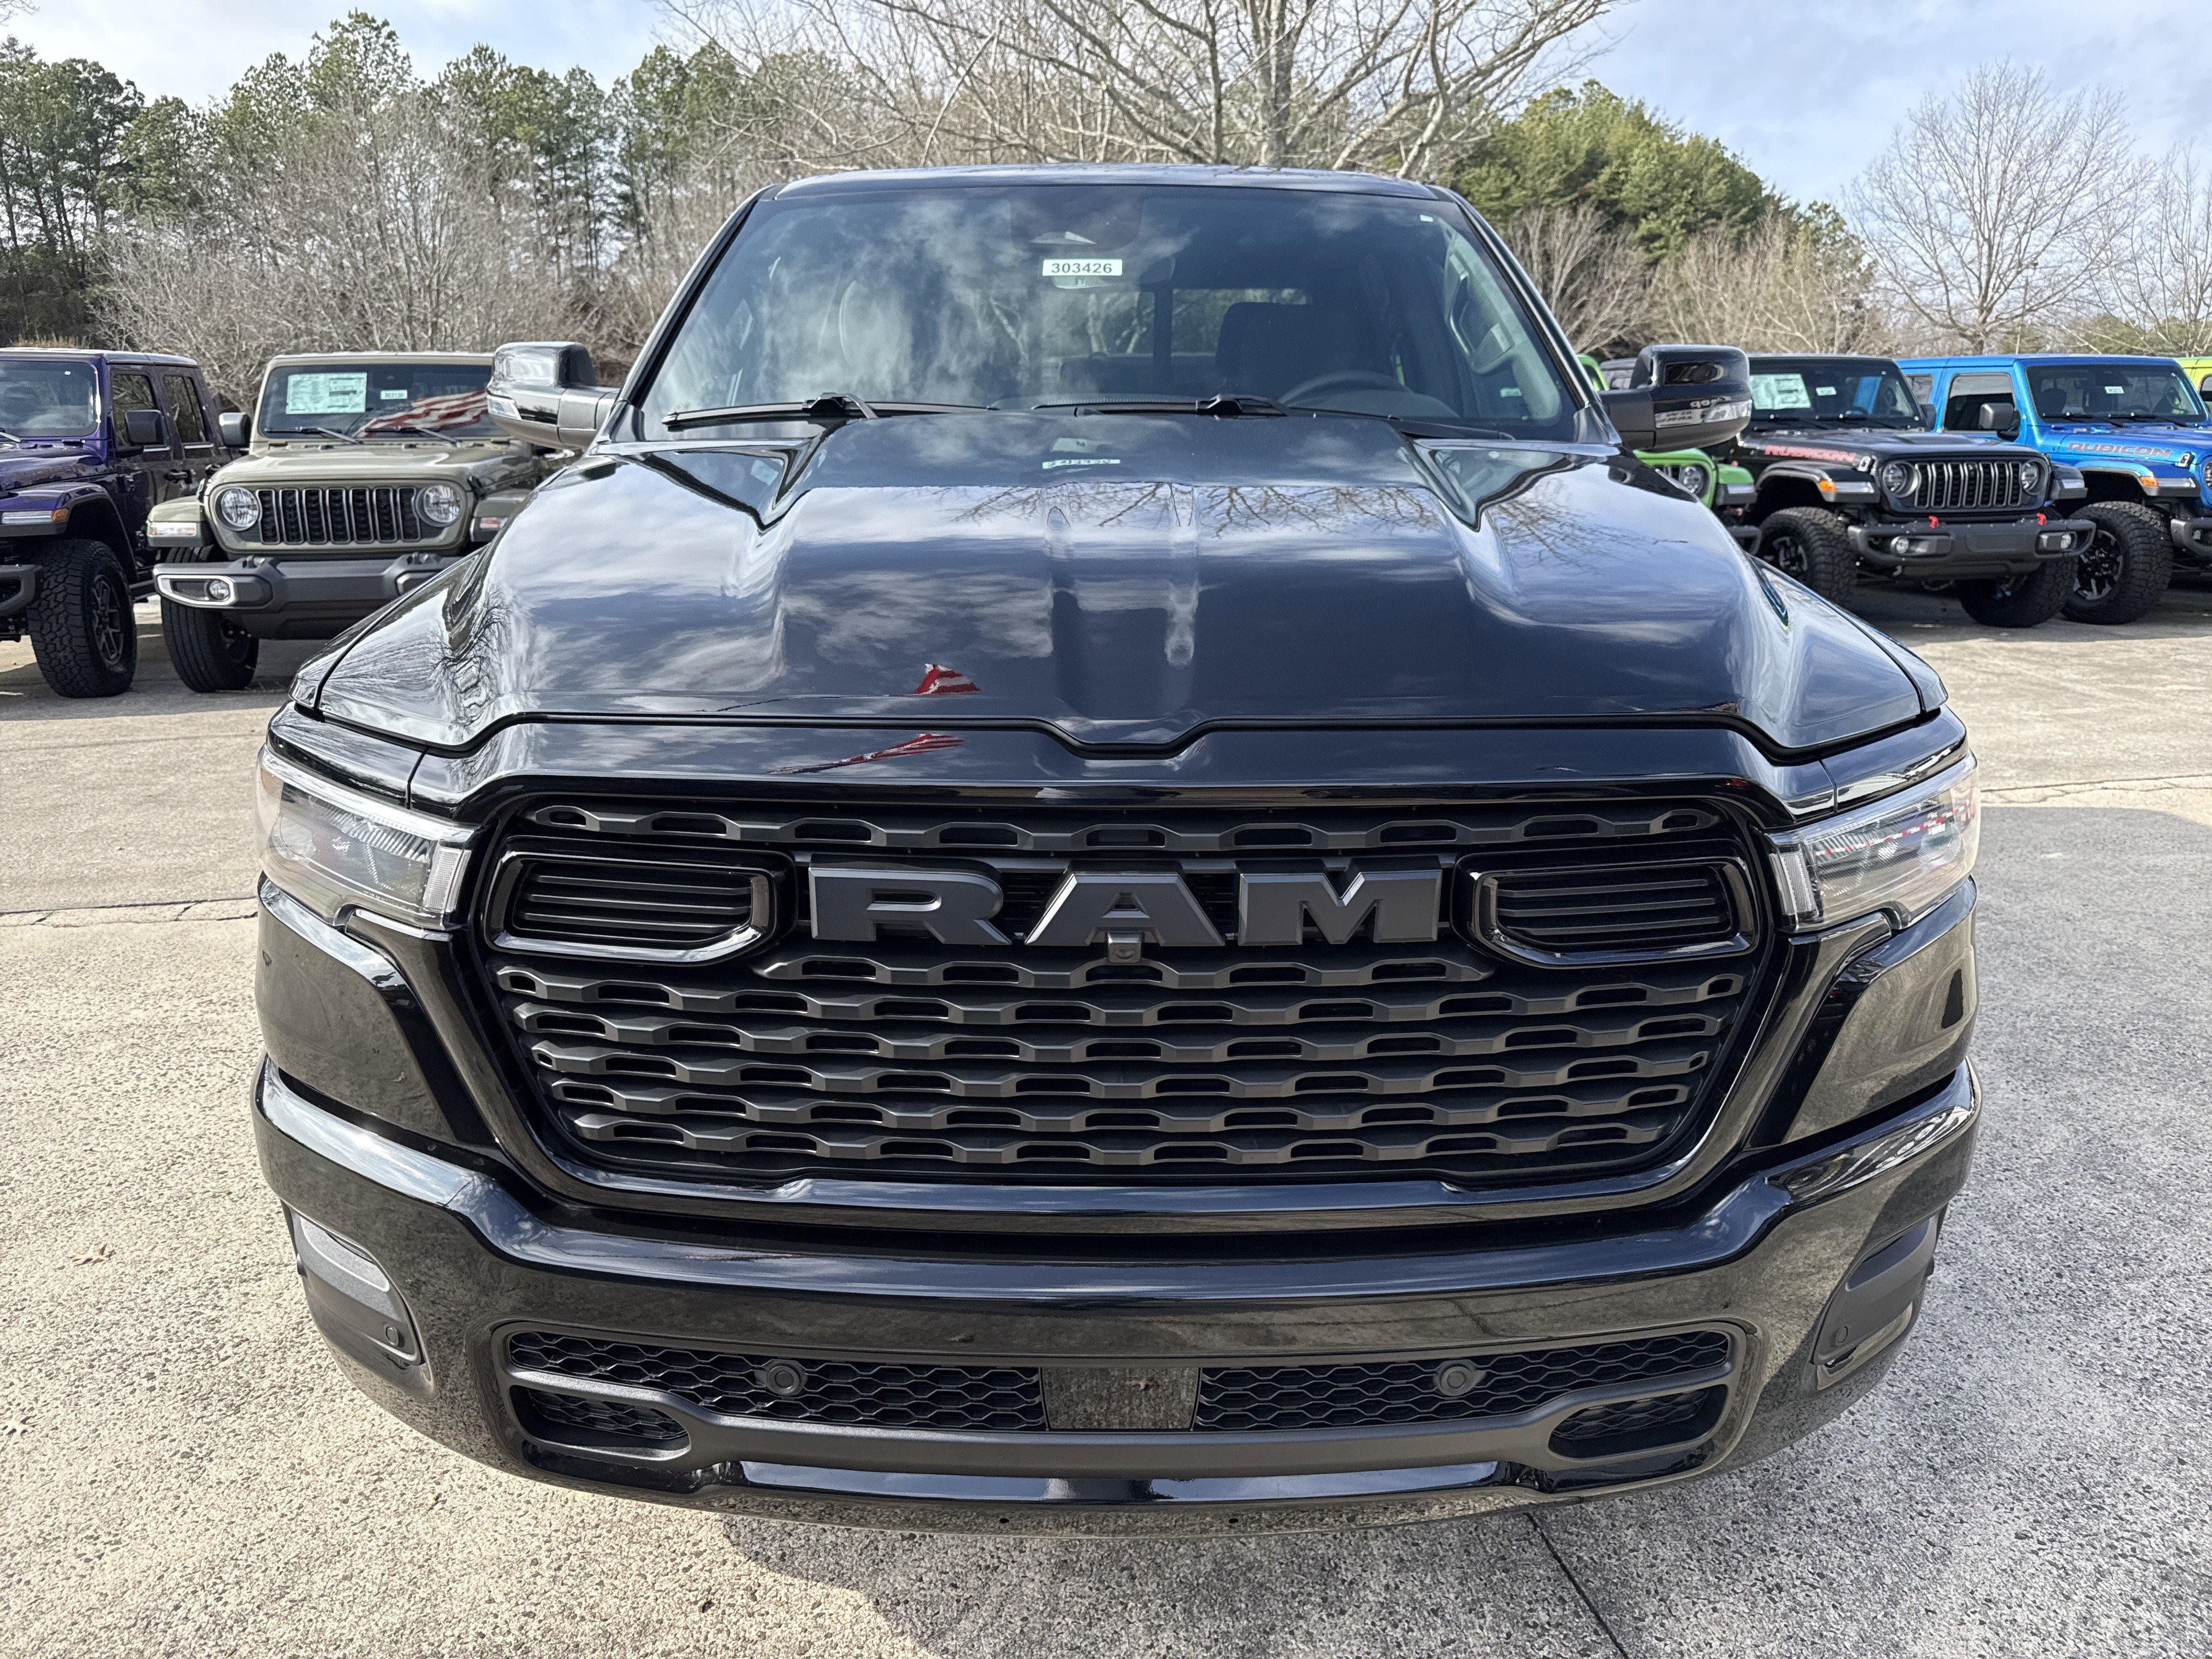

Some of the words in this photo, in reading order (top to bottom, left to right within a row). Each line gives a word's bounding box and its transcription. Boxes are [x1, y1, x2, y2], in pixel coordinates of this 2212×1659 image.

[1051, 263, 1112, 273] 303426
[1764, 445, 1857, 462] RUBICON
[2067, 442, 2171, 457] RUBICON
[808, 856, 1442, 946] RAM
